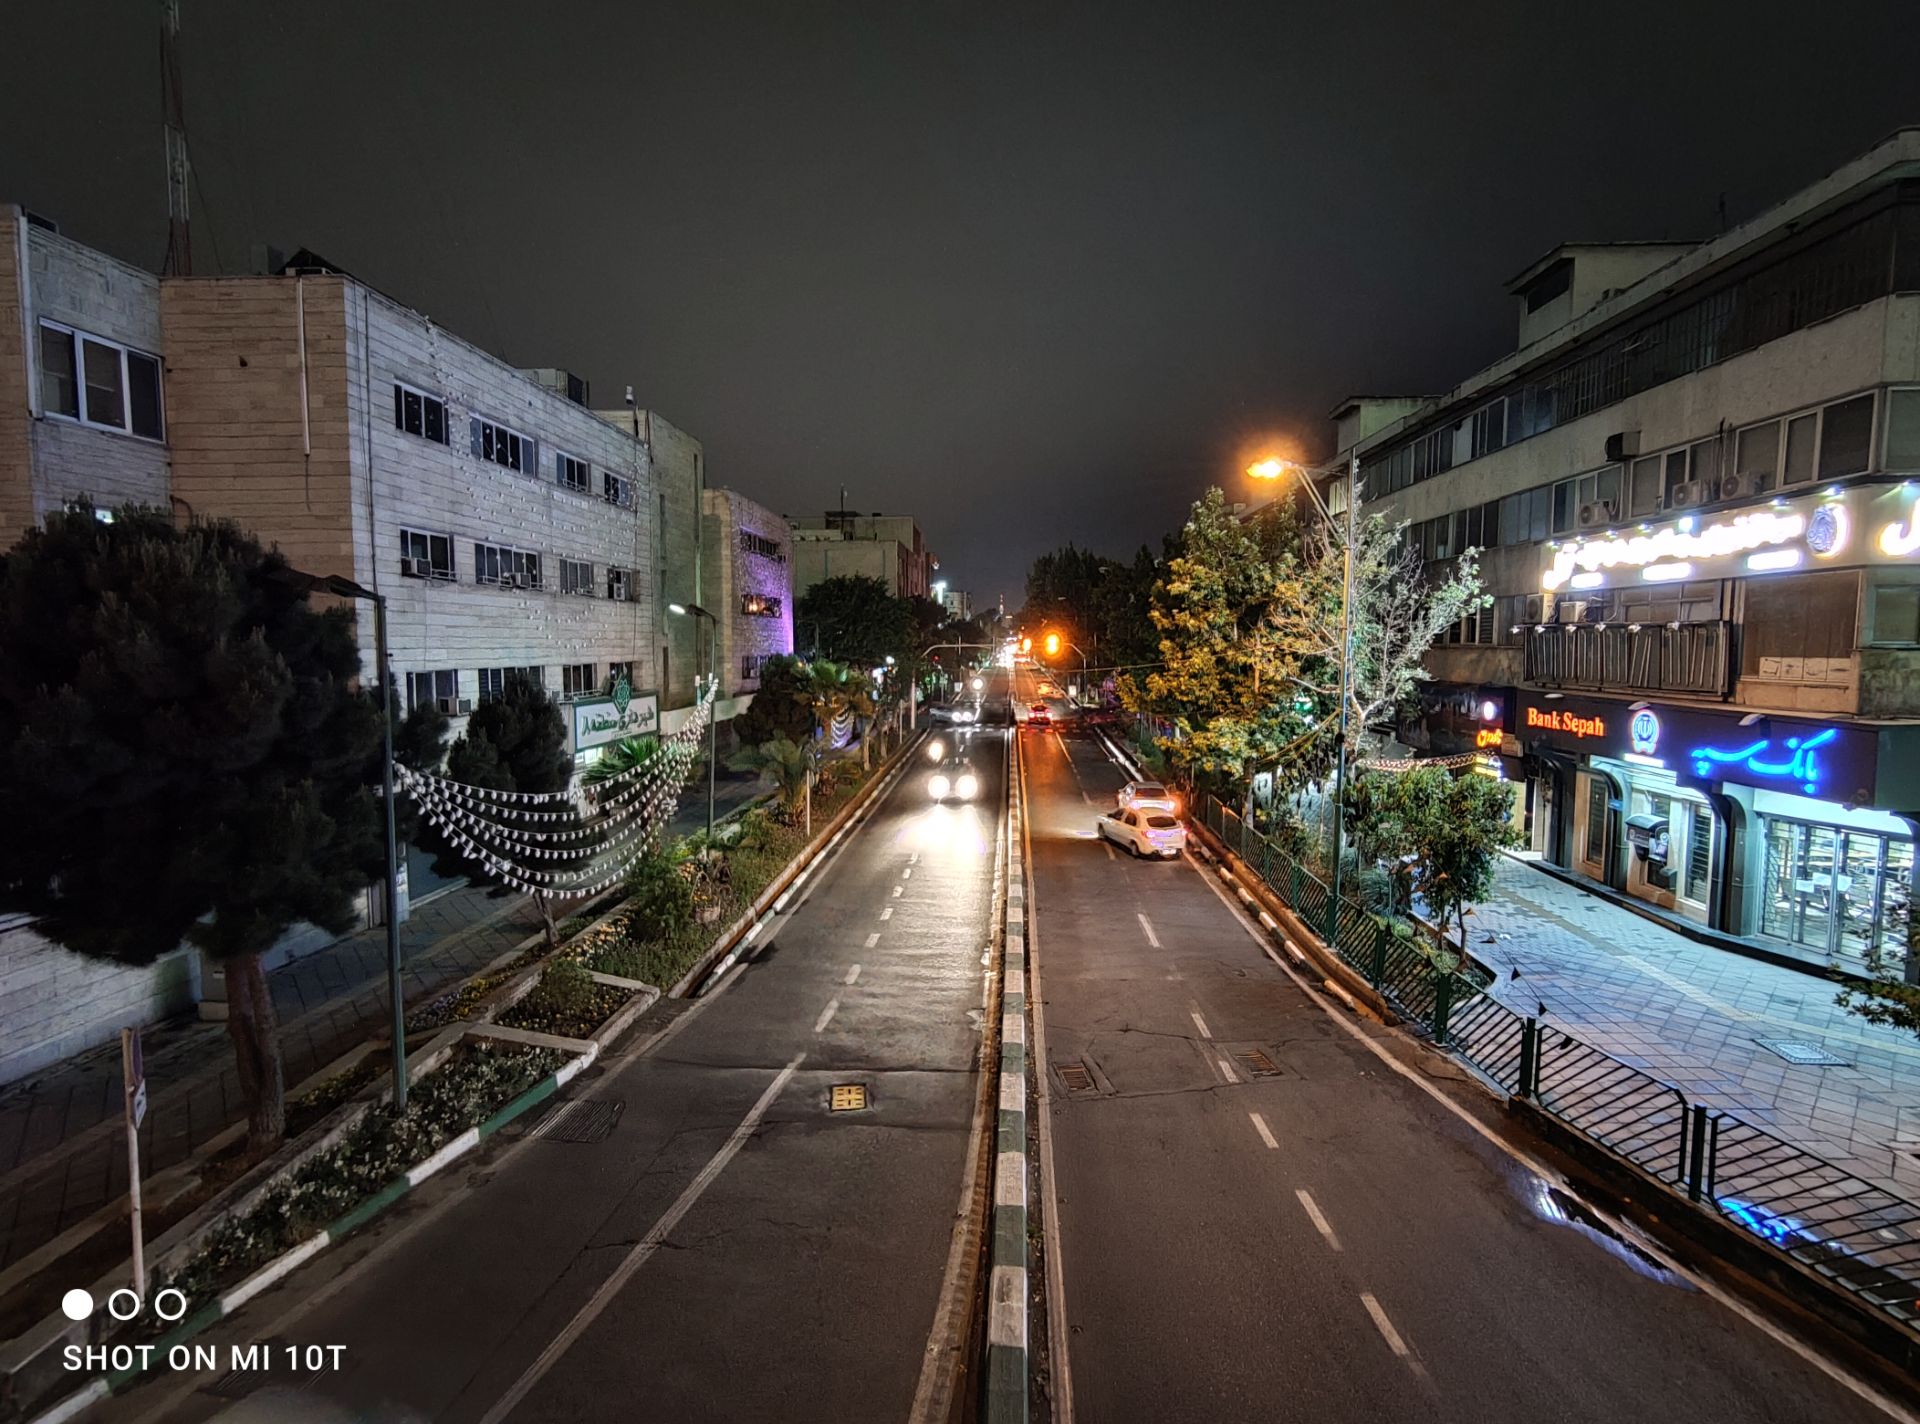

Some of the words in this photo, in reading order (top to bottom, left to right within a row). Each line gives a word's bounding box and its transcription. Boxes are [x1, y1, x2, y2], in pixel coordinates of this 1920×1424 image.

[1527, 707, 1561, 730] Bank
[1562, 712, 1605, 738] Sepah
[1690, 739, 1769, 777] سپه
[1747, 727, 1838, 794] بانک
